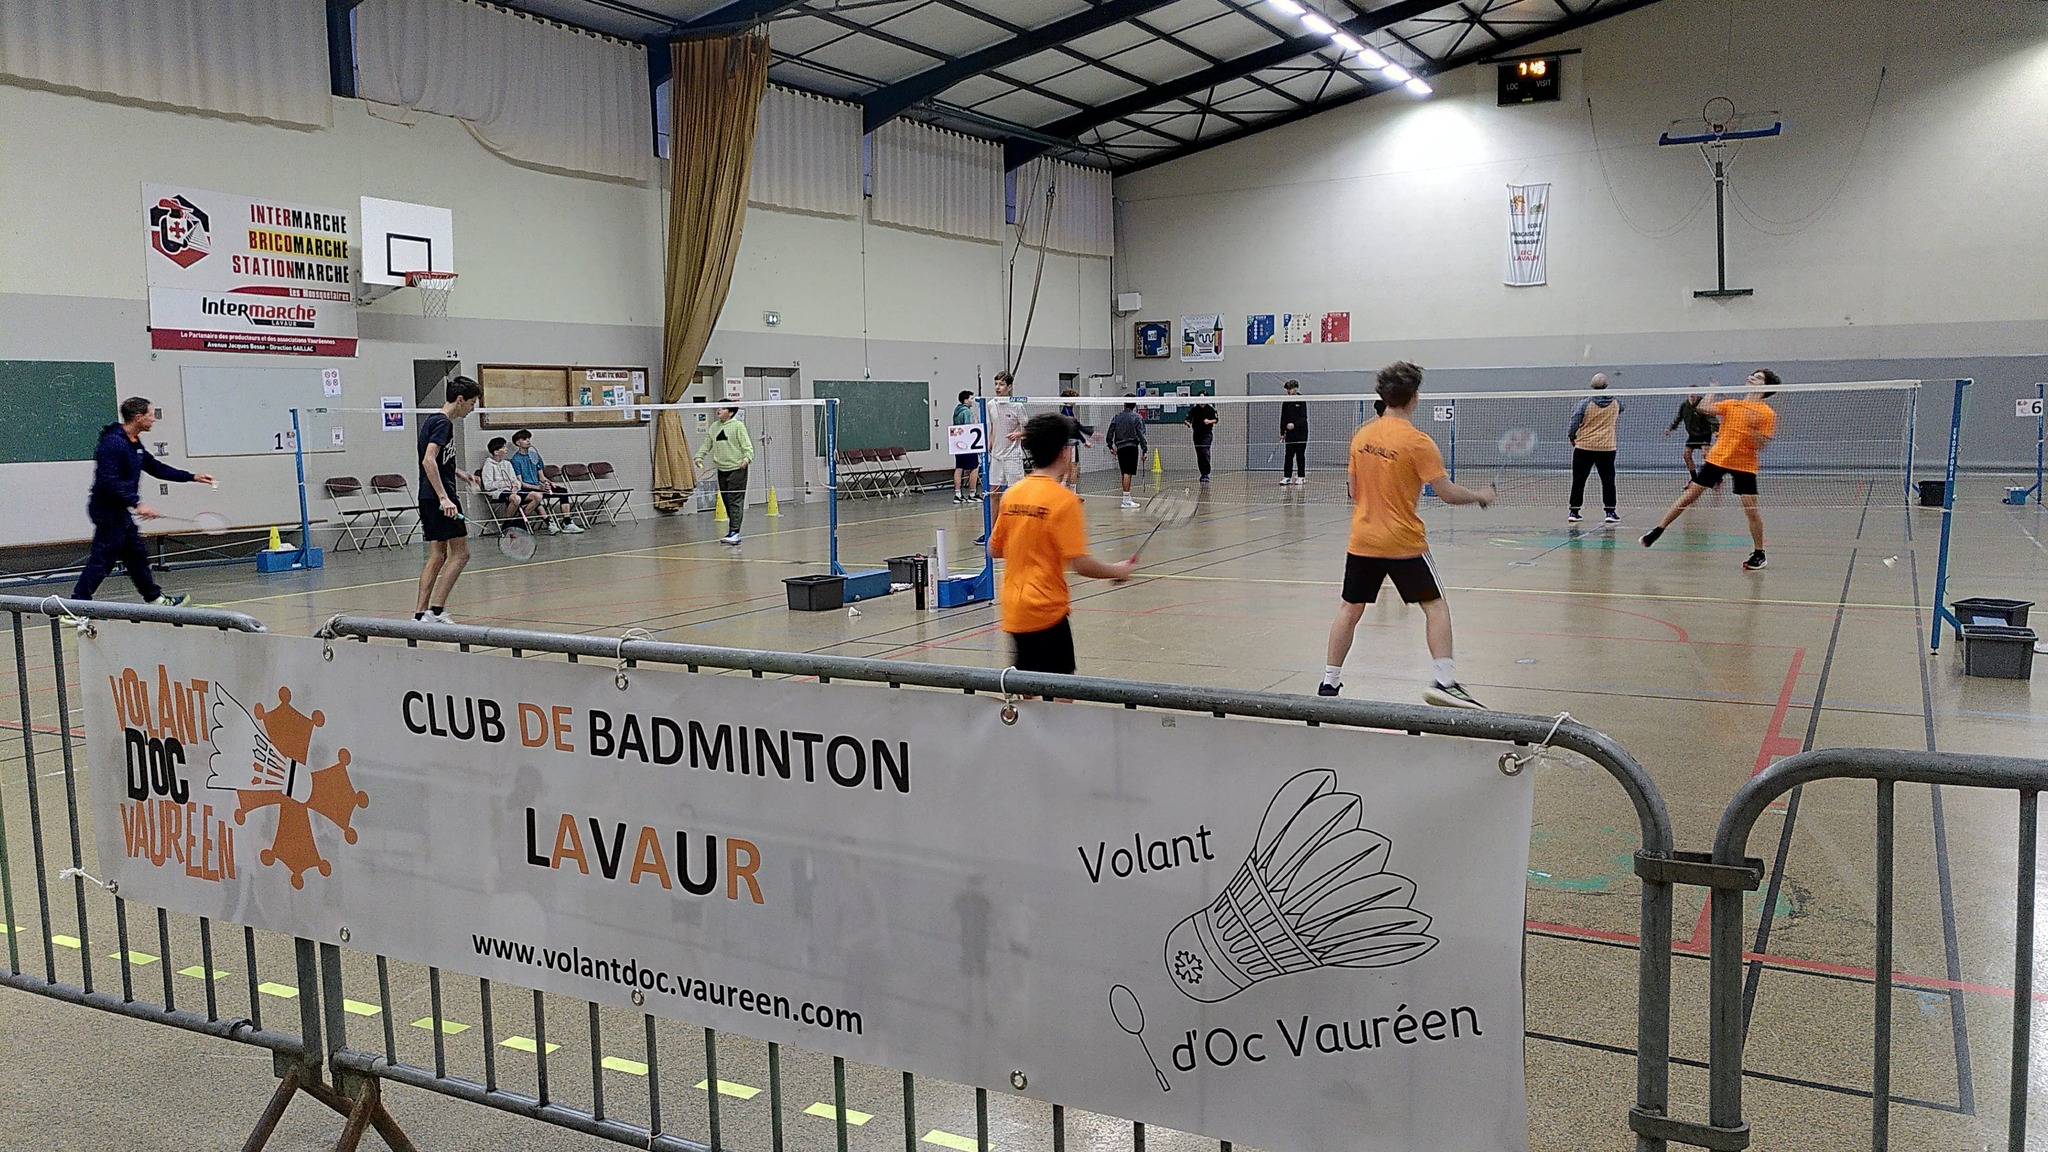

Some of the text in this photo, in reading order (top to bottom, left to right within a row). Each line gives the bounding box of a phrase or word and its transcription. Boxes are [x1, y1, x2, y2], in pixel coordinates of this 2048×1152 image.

[1506, 83, 1519, 91] LOC
[1536, 79, 1551, 87] VISIT
[250, 204, 347, 234] INTERMARCHE
[248, 230, 349, 259] BRICOMARCHE
[232, 254, 350, 284] STATIONMARCHE
[289, 287, 301, 297] Les
[271, 319, 298, 328] LAVAUR
[189, 332, 218, 340] Partenaire
[219, 333, 229, 341] des
[229, 334, 261, 343] producteurs
[267, 335, 276, 343] des
[207, 341, 227, 349] Avenue
[228, 342, 249, 351] Jacques
[1445, 408, 1453, 420] 5
[2031, 401, 2042, 414] 6
[274, 432, 284, 450] 1
[970, 428, 983, 450] 2
[109, 664, 209, 745] VOLANT
[402, 690, 910, 793] CLUB DE BADMINTON
[120, 798, 236, 882] VAUREEN
[526, 807, 764, 905] LAVAUR
[1078, 825, 1215, 884] Volant
[472, 933, 864, 1036] www.volantdoc.vaureen.com
[1171, 1003, 1483, 1073] d'Oc Vauréen
